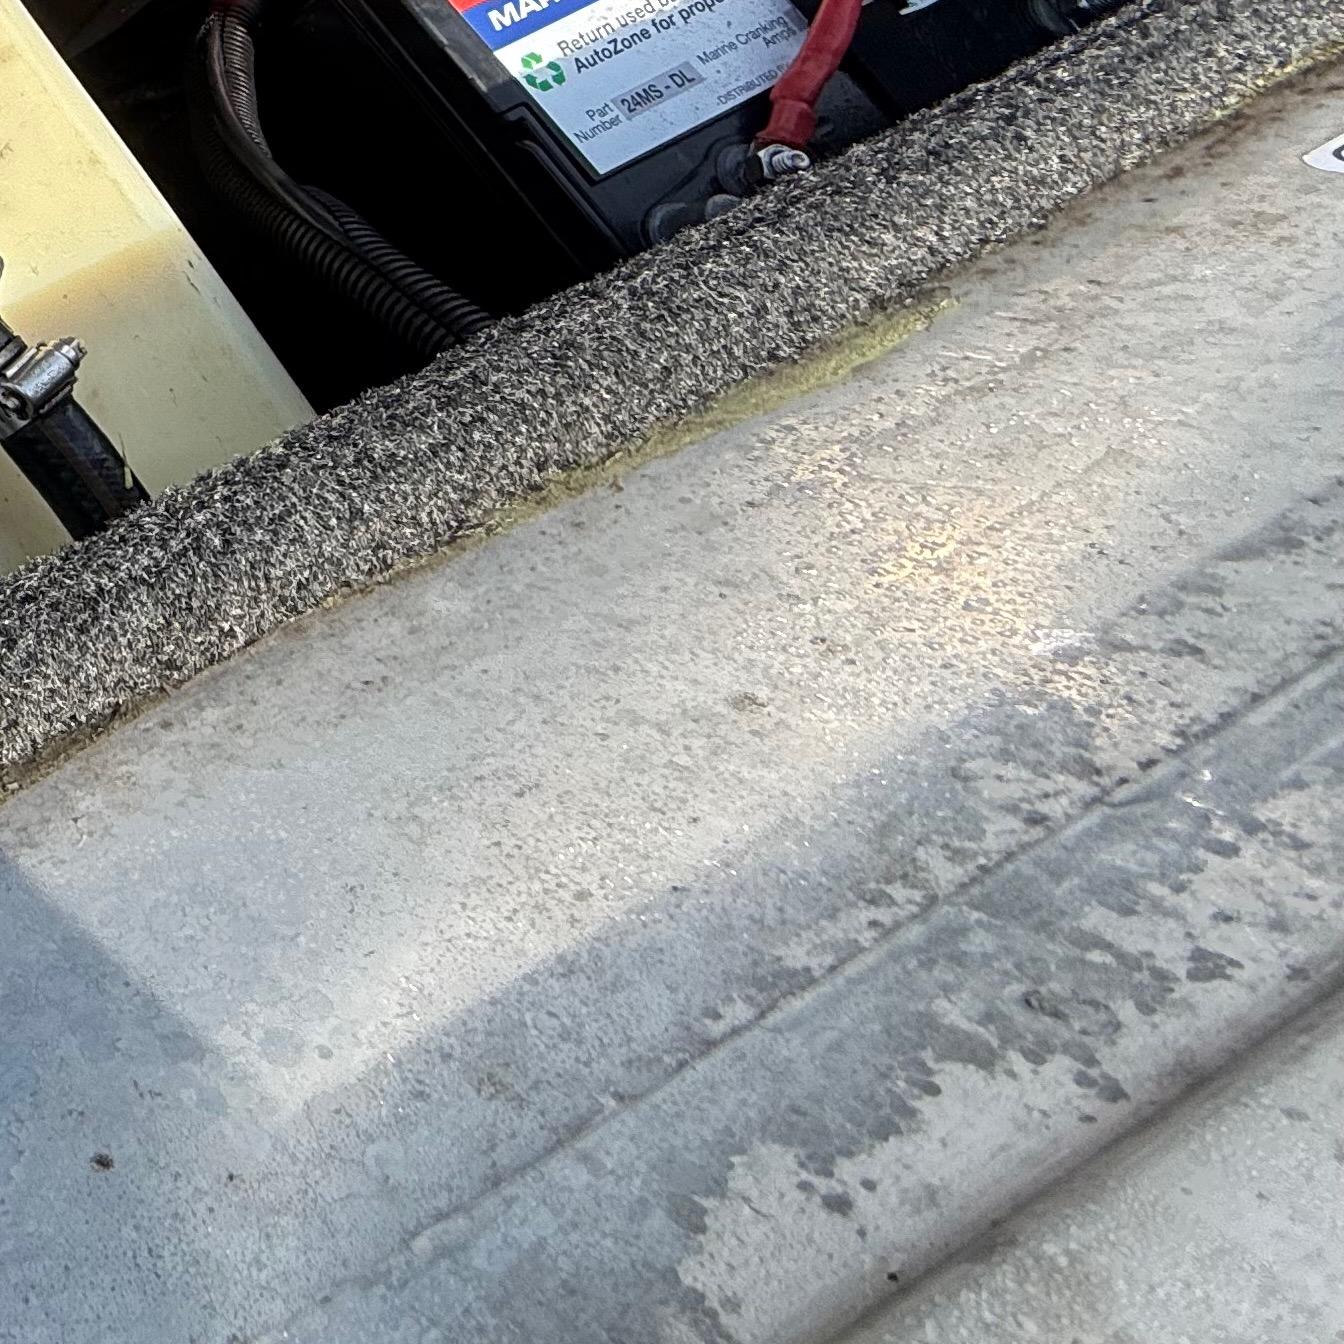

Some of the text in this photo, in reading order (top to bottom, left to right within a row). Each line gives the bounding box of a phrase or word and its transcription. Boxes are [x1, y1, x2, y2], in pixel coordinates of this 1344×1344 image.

[557, 19, 615, 57] Return
[615, 0, 655, 28] used
[571, 23, 652, 74] AutoZone
[650, 11, 678, 34] for
[696, 13, 788, 67] Marine Cranking
[586, 101, 614, 122] Part
[620, 82, 664, 114] 24MS
[669, 66, 696, 89] DL
[762, 24, 796, 49] Amps
[717, 69, 779, 105] DISTRIBUTED
[574, 113, 623, 144] Number
